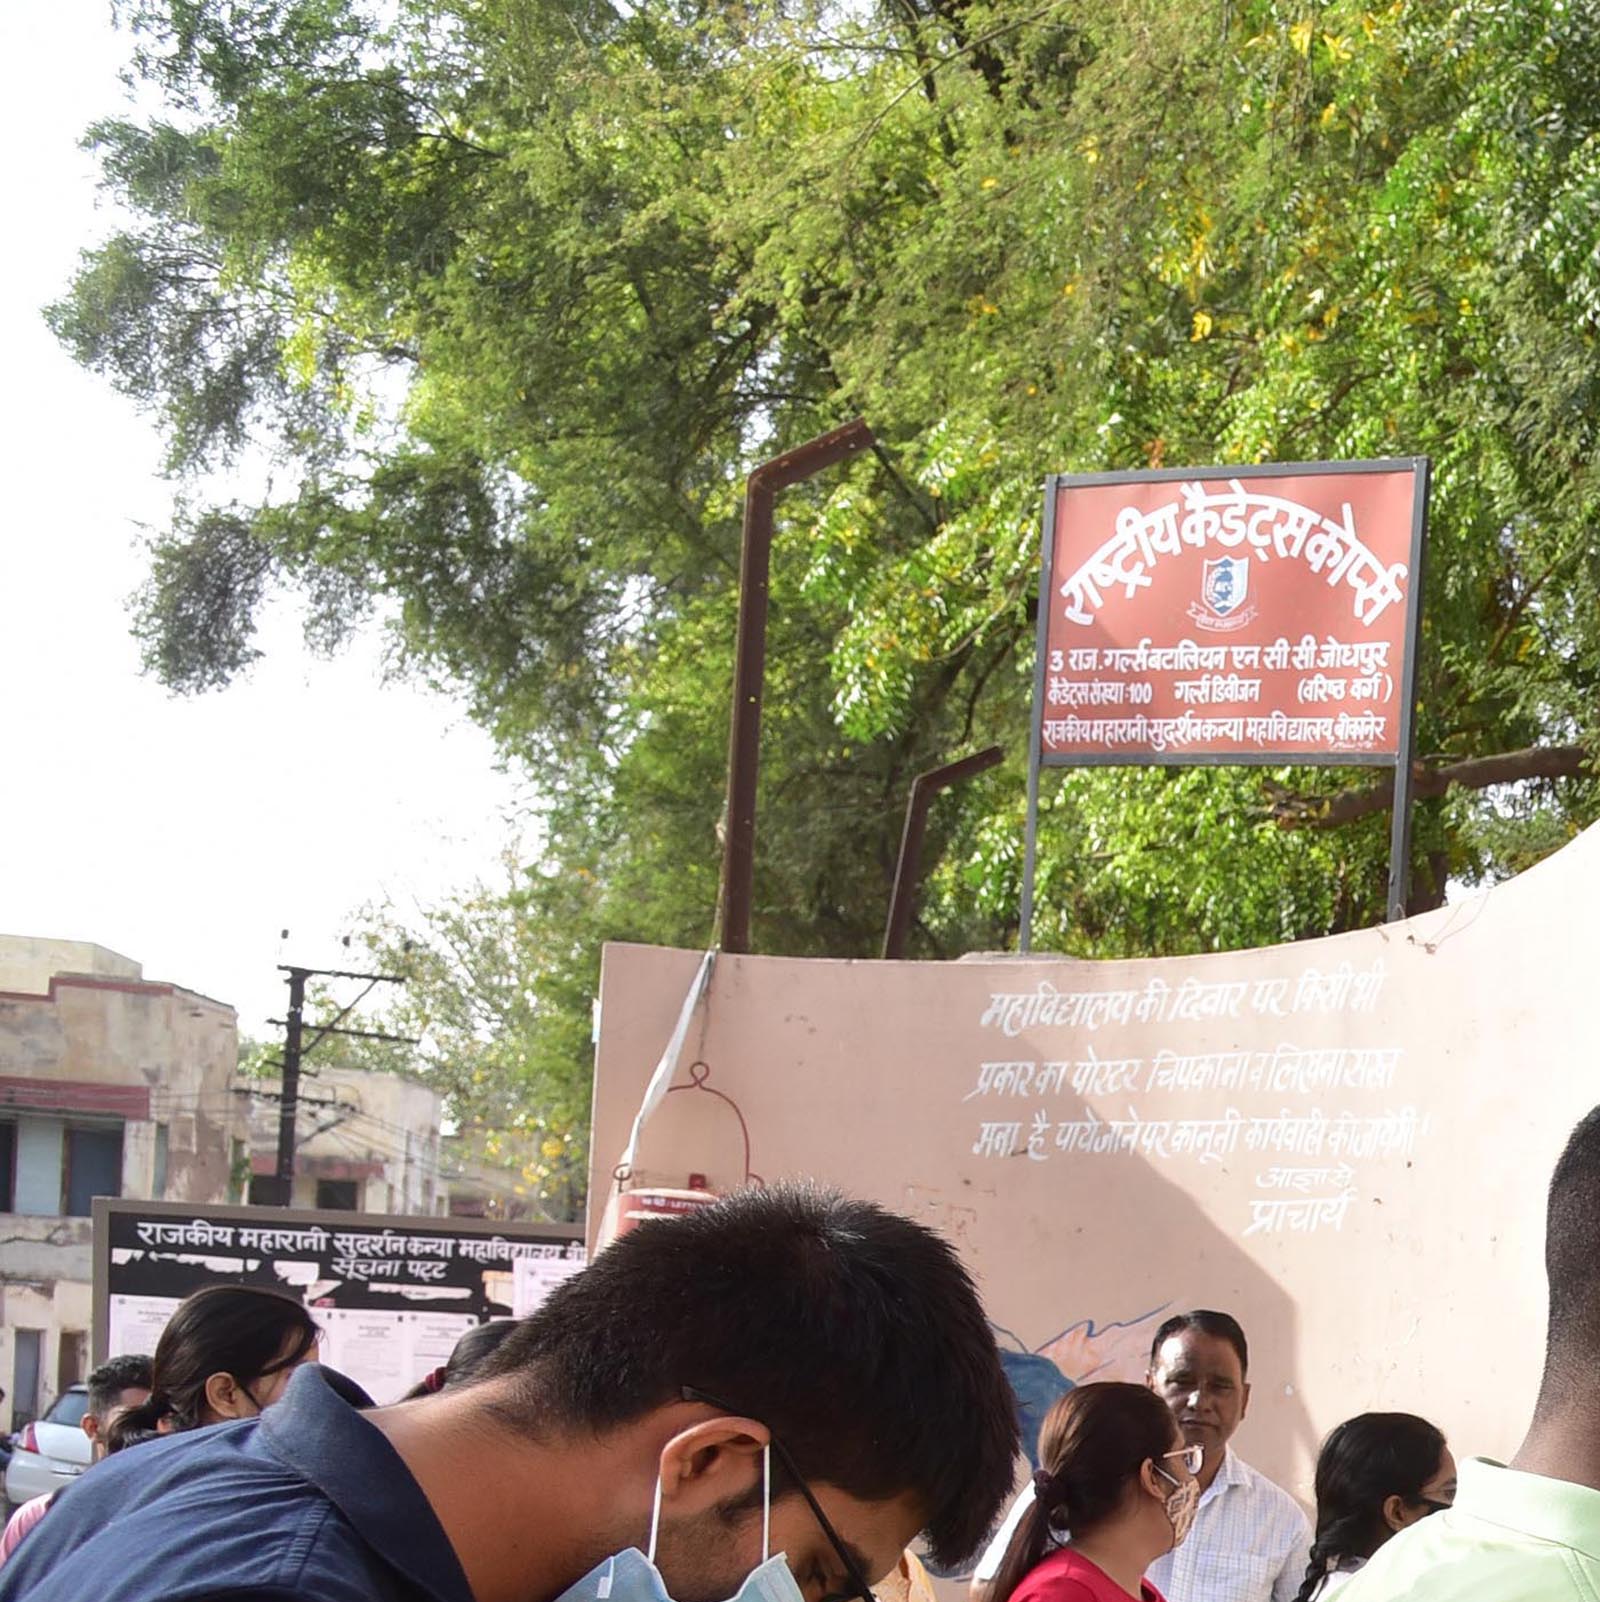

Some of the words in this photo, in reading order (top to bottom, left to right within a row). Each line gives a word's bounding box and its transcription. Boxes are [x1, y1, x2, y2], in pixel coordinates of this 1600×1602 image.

[1060, 503, 1181, 625] राष्ट्रीय
[1181, 479, 1322, 562] कैडेट्स
[1050, 651, 1063, 672] 3
[1104, 638, 1151, 673] गर्ल्स
[1150, 639, 1228, 670] बटालियन
[1317, 635, 1390, 675] जोधपुर
[1048, 676, 1089, 709] कैडेट्स
[1090, 678, 1125, 705] संख्या
[1174, 673, 1213, 703] गर्ल्स
[1212, 673, 1261, 703] डिवीजन
[1042, 714, 1091, 748] राजकीय
[1092, 714, 1148, 748] महारानी
[1148, 710, 1203, 751] सुदर्शन
[1202, 716, 1243, 742] कन्या
[1334, 711, 1386, 741] बीकानेर
[980, 980, 1138, 1036] महाविद्यालय
[1136, 978, 1170, 1022] की
[1250, 979, 1289, 1016] पर
[964, 1061, 1035, 1100] प्रकार
[1035, 1061, 1068, 1096] का
[1146, 1049, 1251, 1092] चिपकाना
[973, 1121, 1022, 1158] मना
[1027, 1108, 1051, 1161] है
[1055, 1106, 1102, 1153] पाये
[1094, 1105, 1141, 1155] जाने
[1140, 1121, 1173, 1158] पर
[1172, 1106, 1248, 1163] कानूनी
[1256, 1165, 1329, 1192] आज्ञा
[1242, 1187, 1358, 1236] प्राचार्य
[137, 1219, 235, 1247] राजकीय
[238, 1226, 330, 1254] महारानी
[333, 1229, 407, 1259] सुदर्शन
[406, 1234, 456, 1258] कन्या
[459, 1236, 565, 1265] महाविद्यालय
[331, 1256, 404, 1281] सूचना
